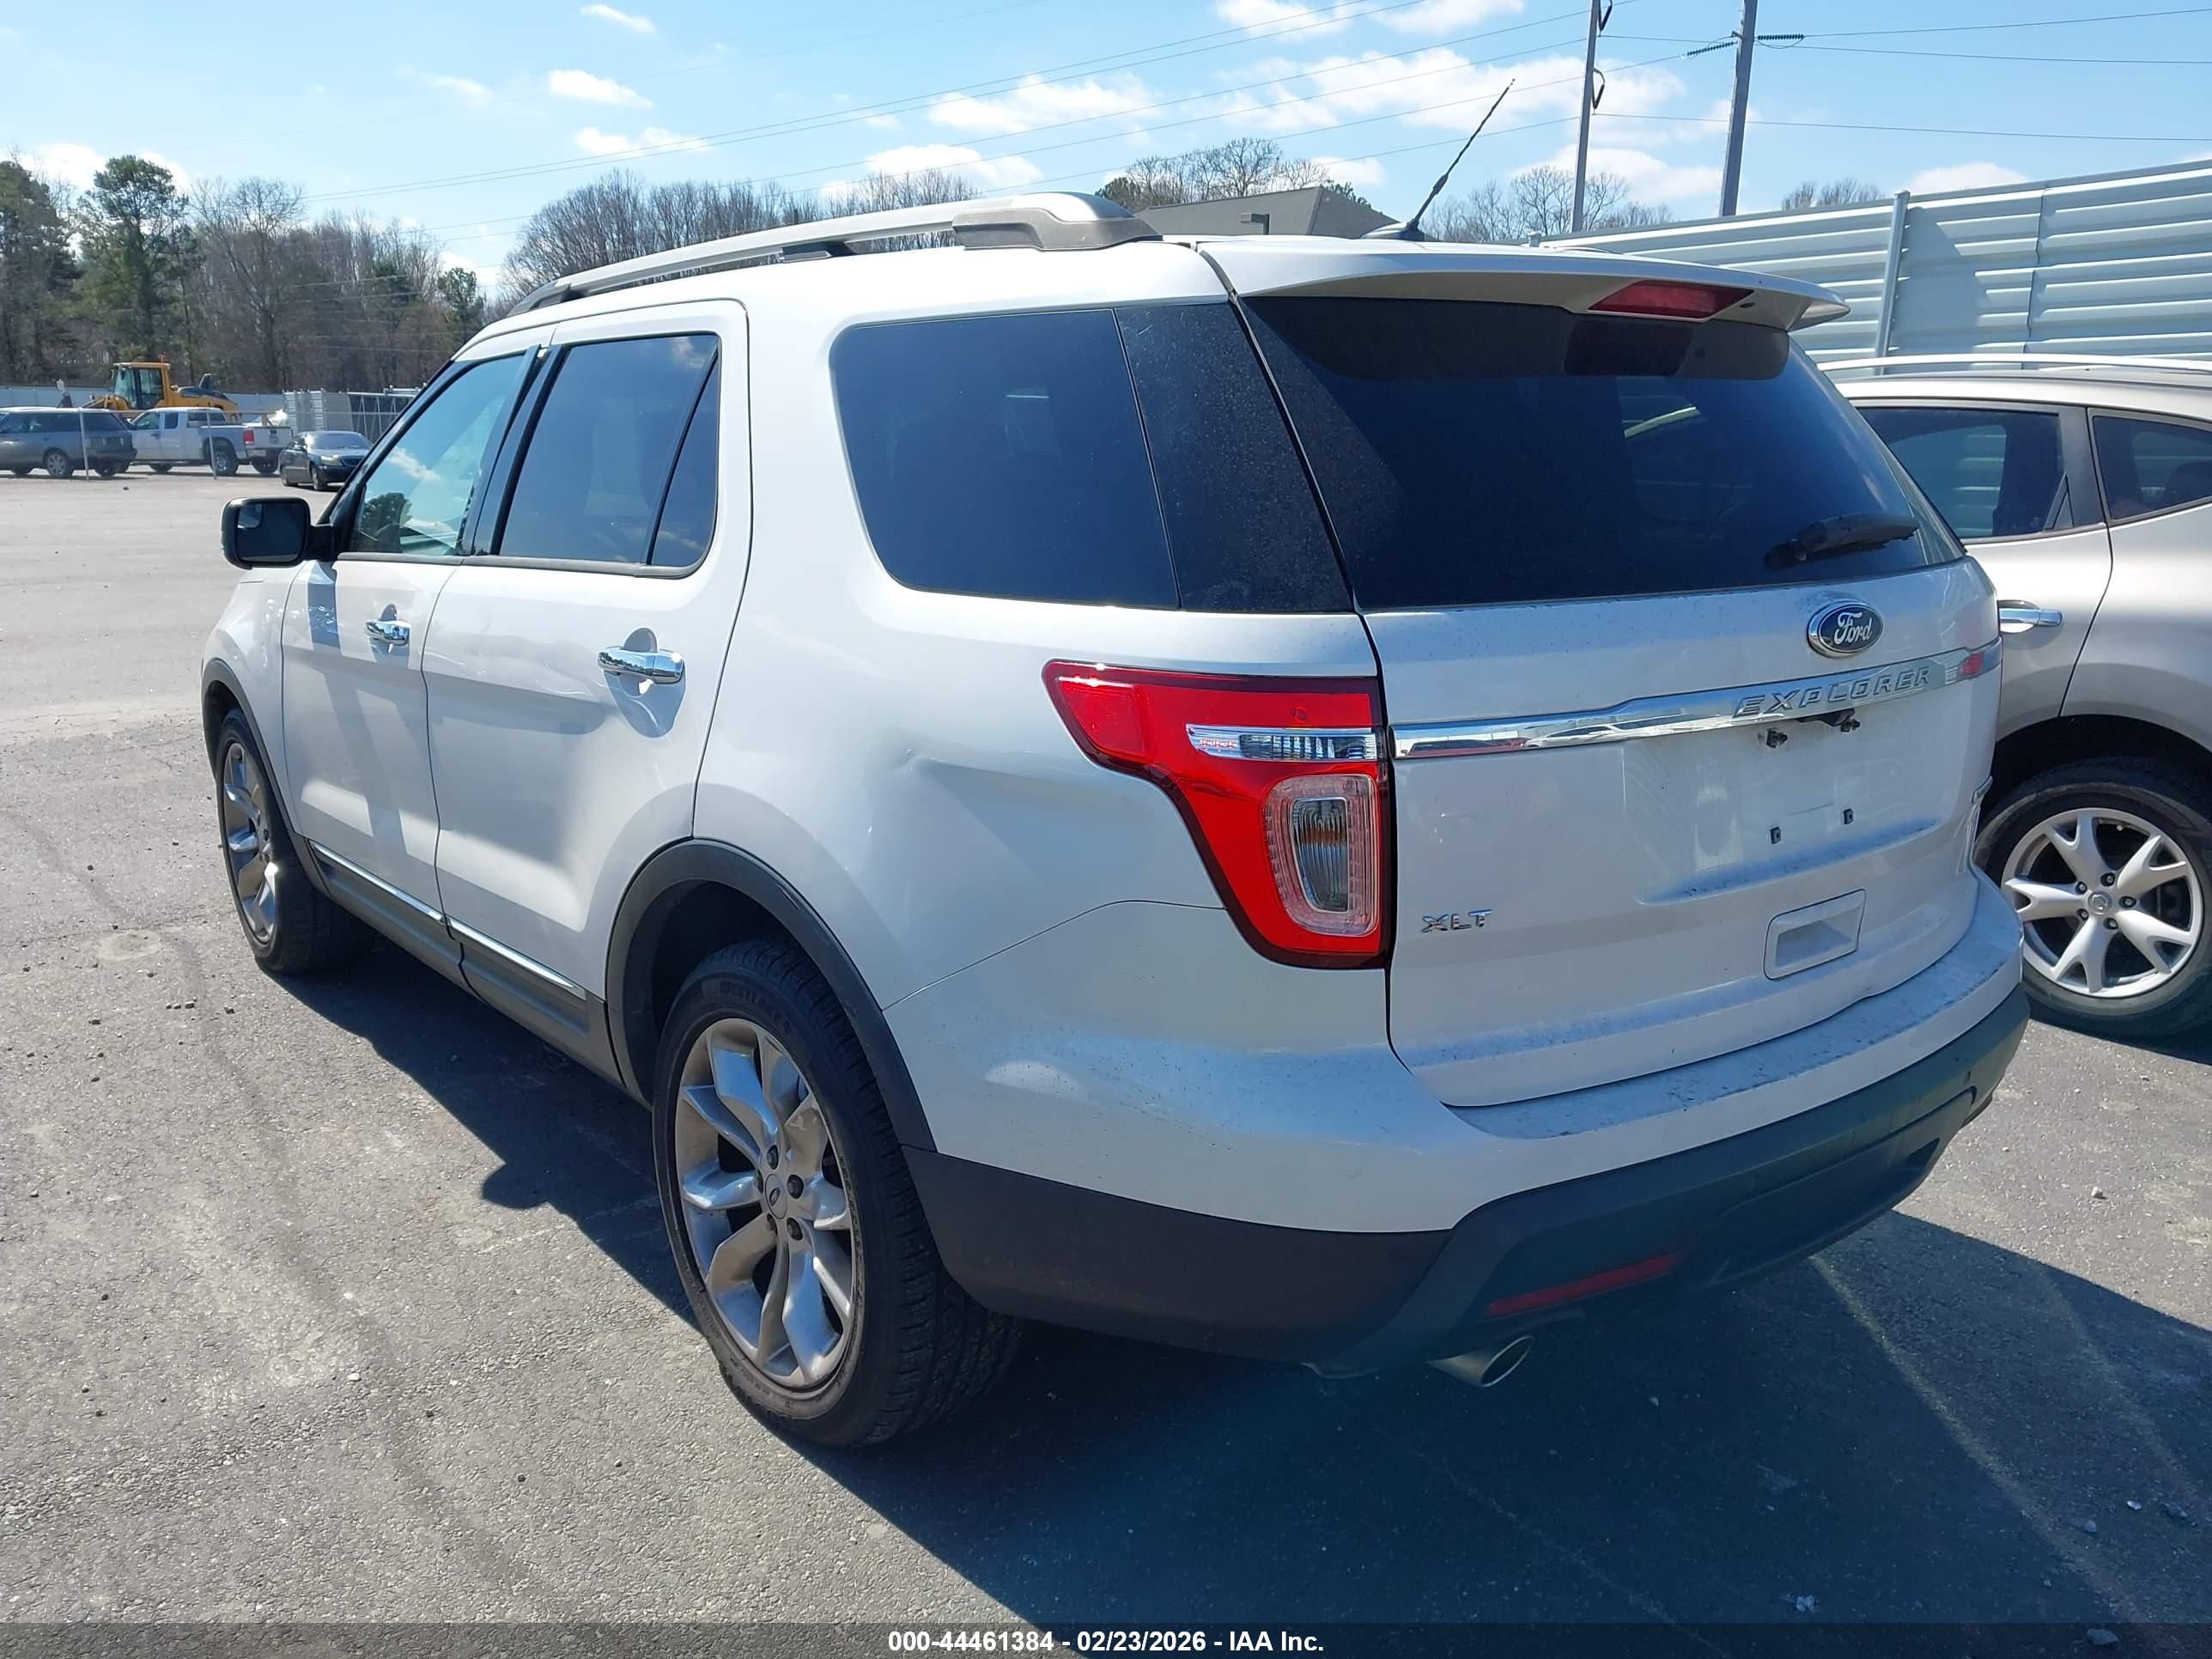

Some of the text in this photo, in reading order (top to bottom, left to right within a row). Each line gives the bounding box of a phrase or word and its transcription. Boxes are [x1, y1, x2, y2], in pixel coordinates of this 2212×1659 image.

[1833, 611, 1873, 645] Ford
[1732, 665, 1930, 718] EXPLORER
[1420, 908, 1493, 933] XLT
